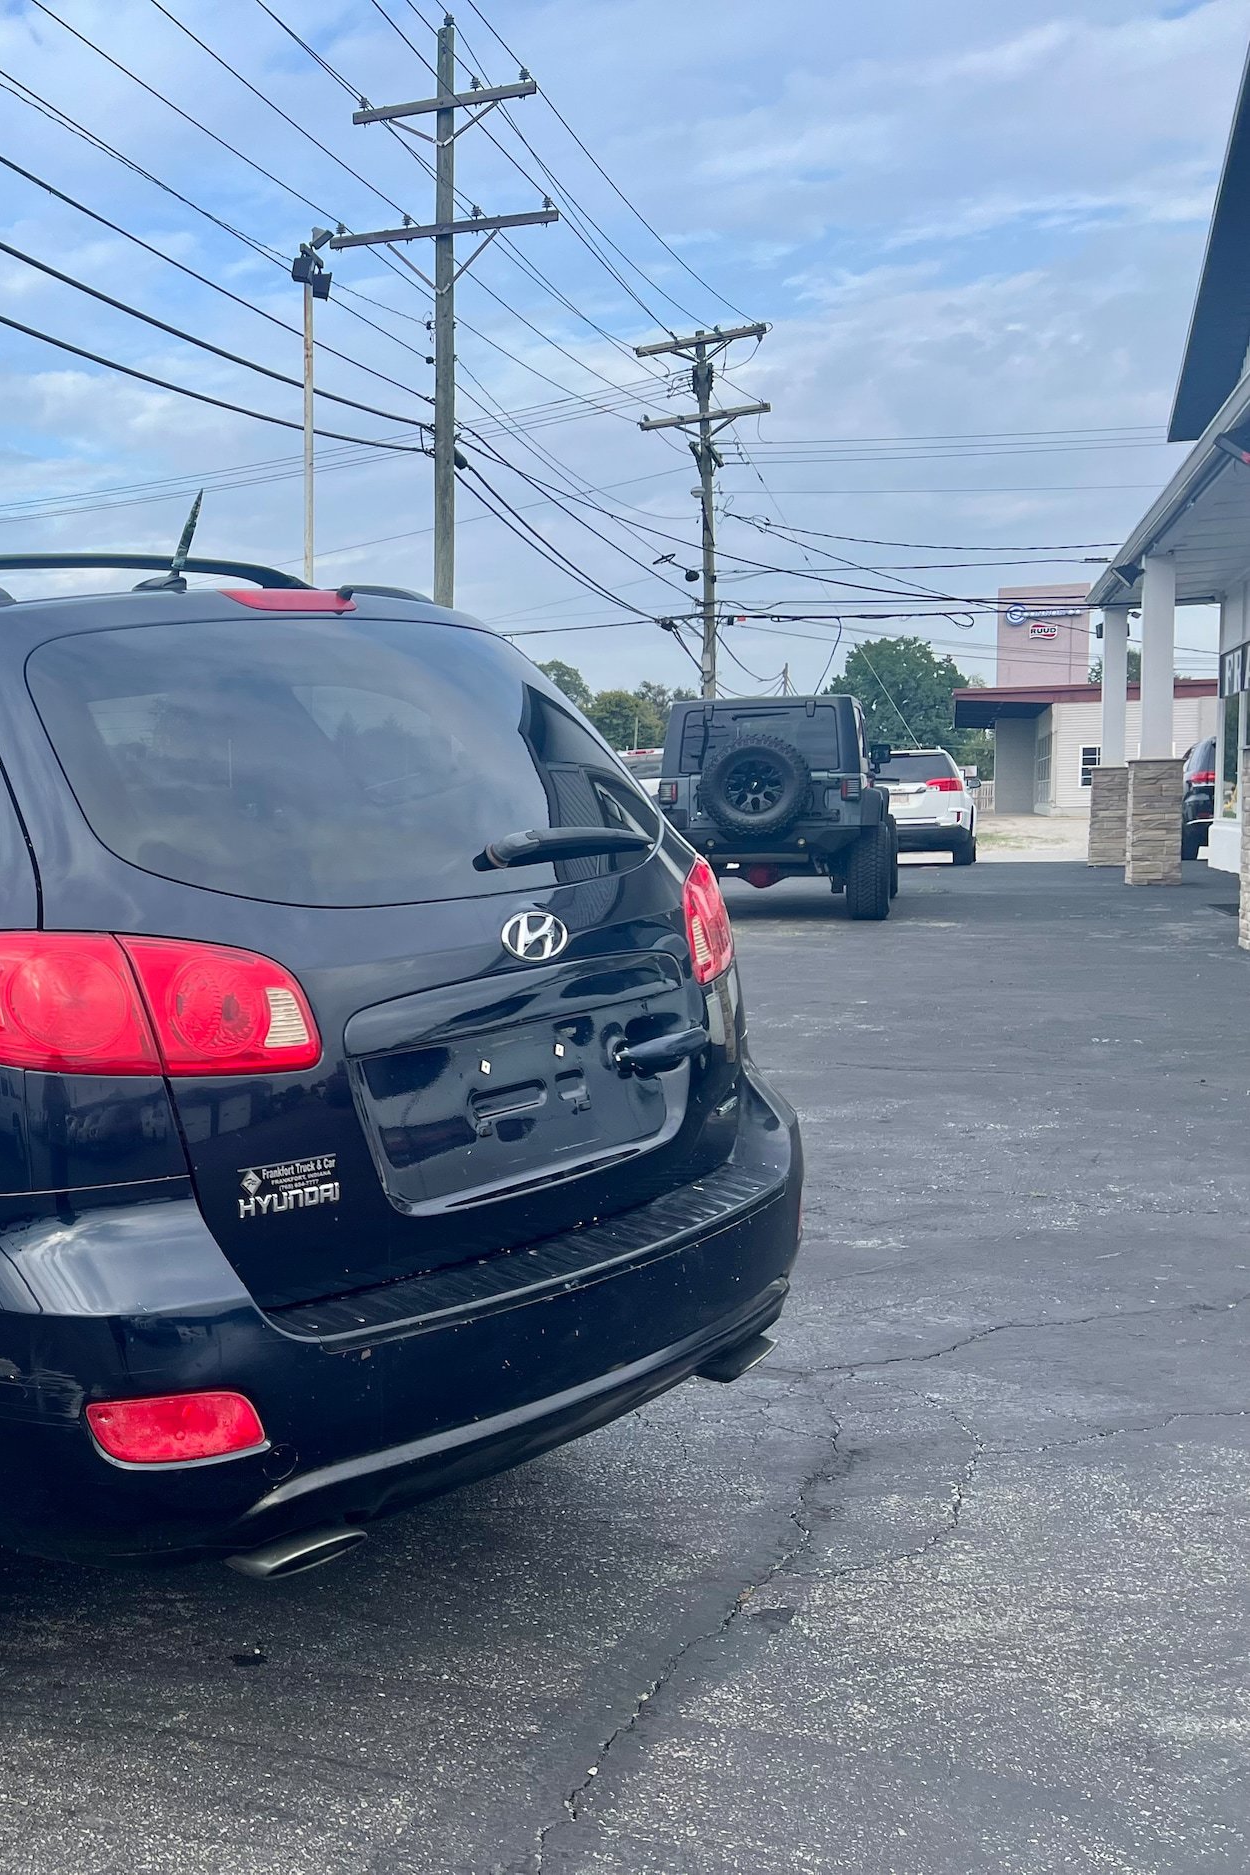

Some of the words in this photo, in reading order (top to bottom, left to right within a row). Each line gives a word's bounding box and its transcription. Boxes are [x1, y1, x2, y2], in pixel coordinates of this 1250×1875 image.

[261, 1166, 295, 1180] Frankfort
[295, 1160, 316, 1174] Truck
[316, 1159, 322, 1170] &
[323, 1158, 336, 1169] Car
[307, 1170, 331, 1179] INDIANA
[237, 1181, 340, 1219] HYUNDAI
